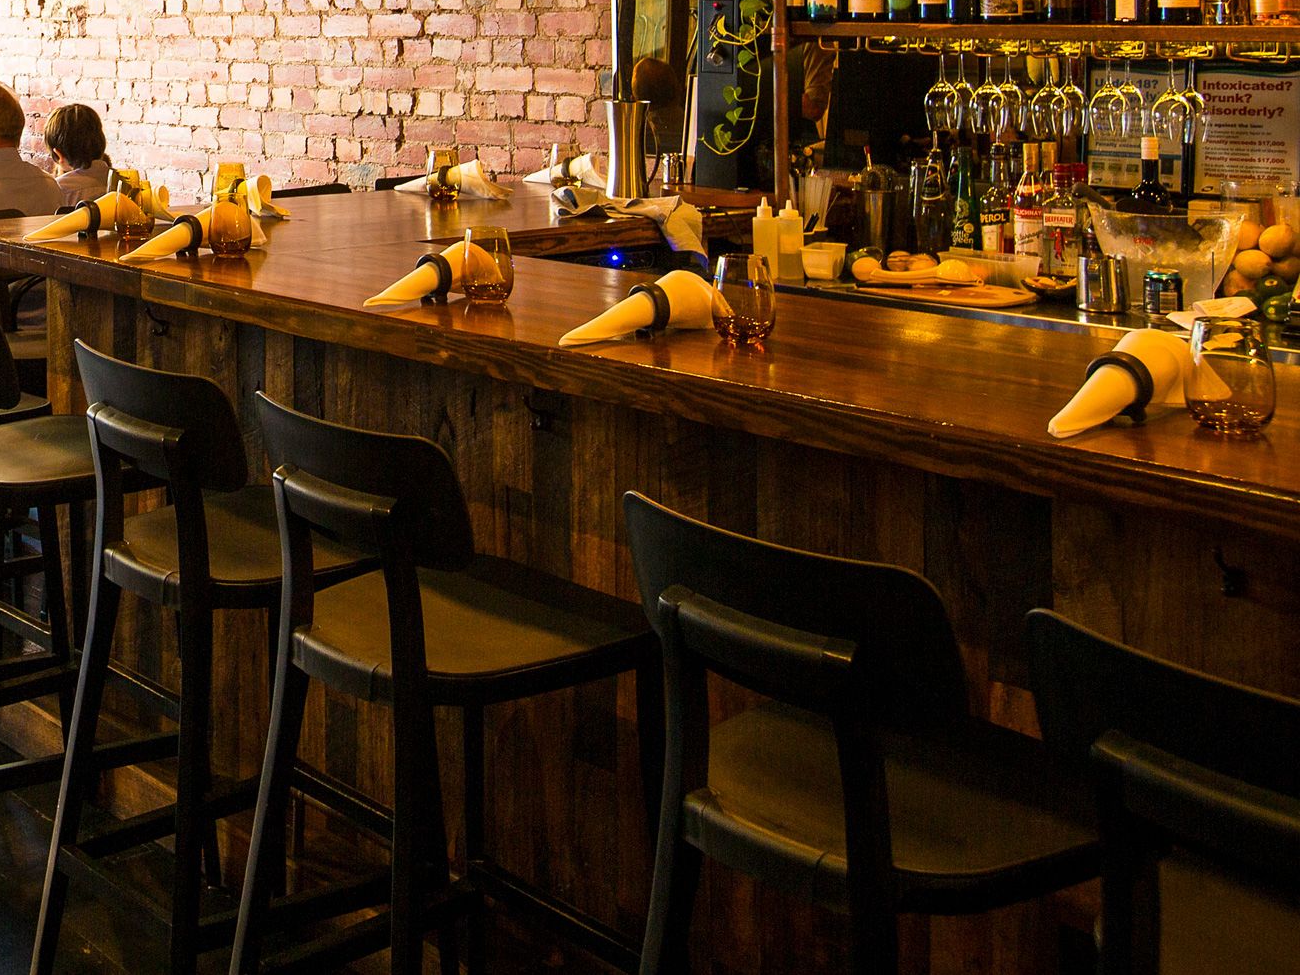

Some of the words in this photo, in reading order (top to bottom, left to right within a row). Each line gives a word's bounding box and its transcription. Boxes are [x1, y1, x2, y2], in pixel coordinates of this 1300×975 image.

[1202, 80, 1293, 91] Intoxicated?
[1202, 93, 1252, 103] Drunk?
[1204, 155, 1229, 163] Penalty
